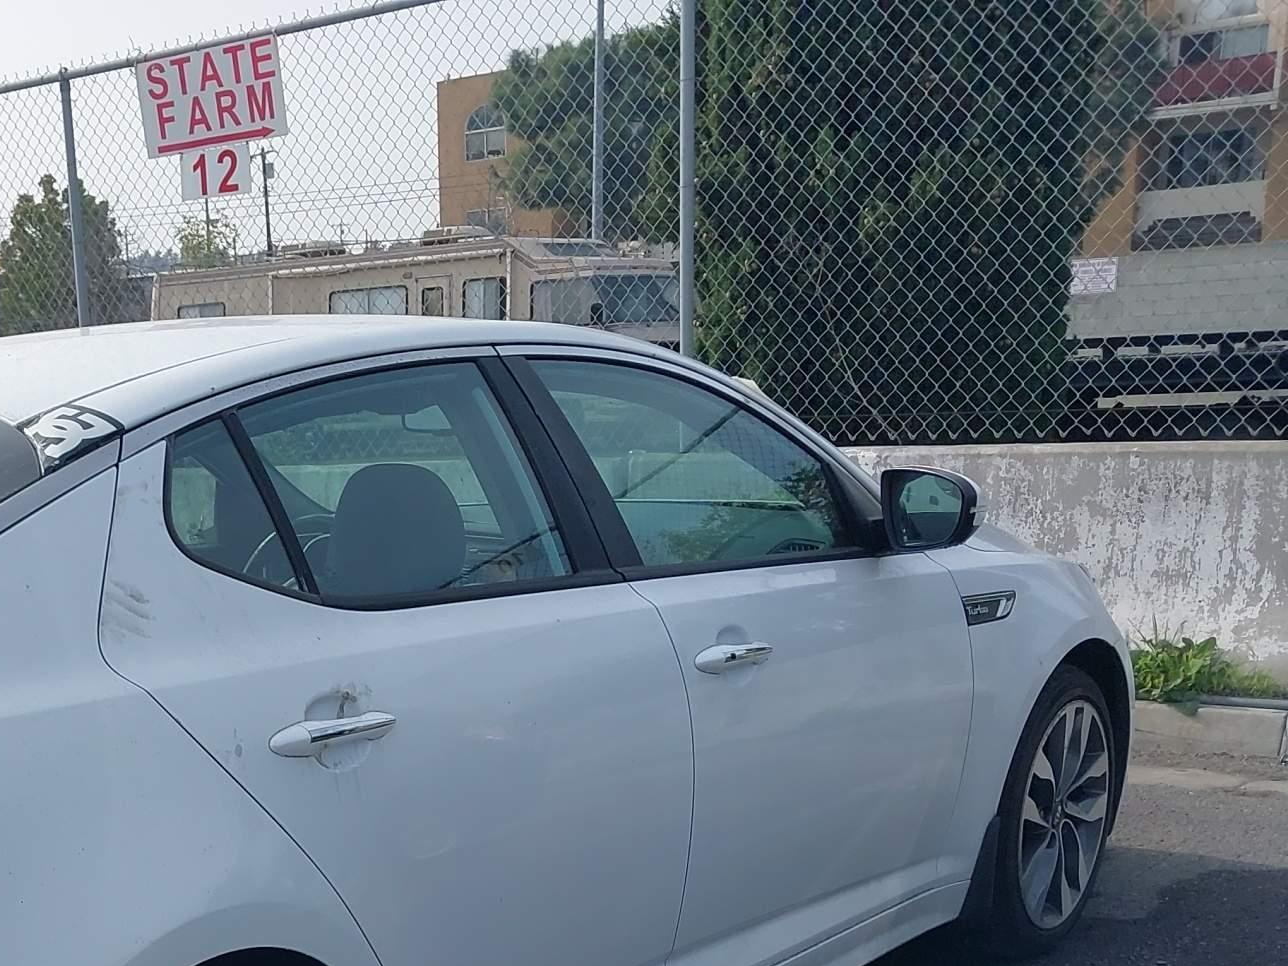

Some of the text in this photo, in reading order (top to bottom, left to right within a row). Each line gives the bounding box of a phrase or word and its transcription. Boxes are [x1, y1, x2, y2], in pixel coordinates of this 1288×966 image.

[145, 38, 276, 100] STATE
[156, 81, 275, 140] FARM
[192, 149, 239, 195] 12
